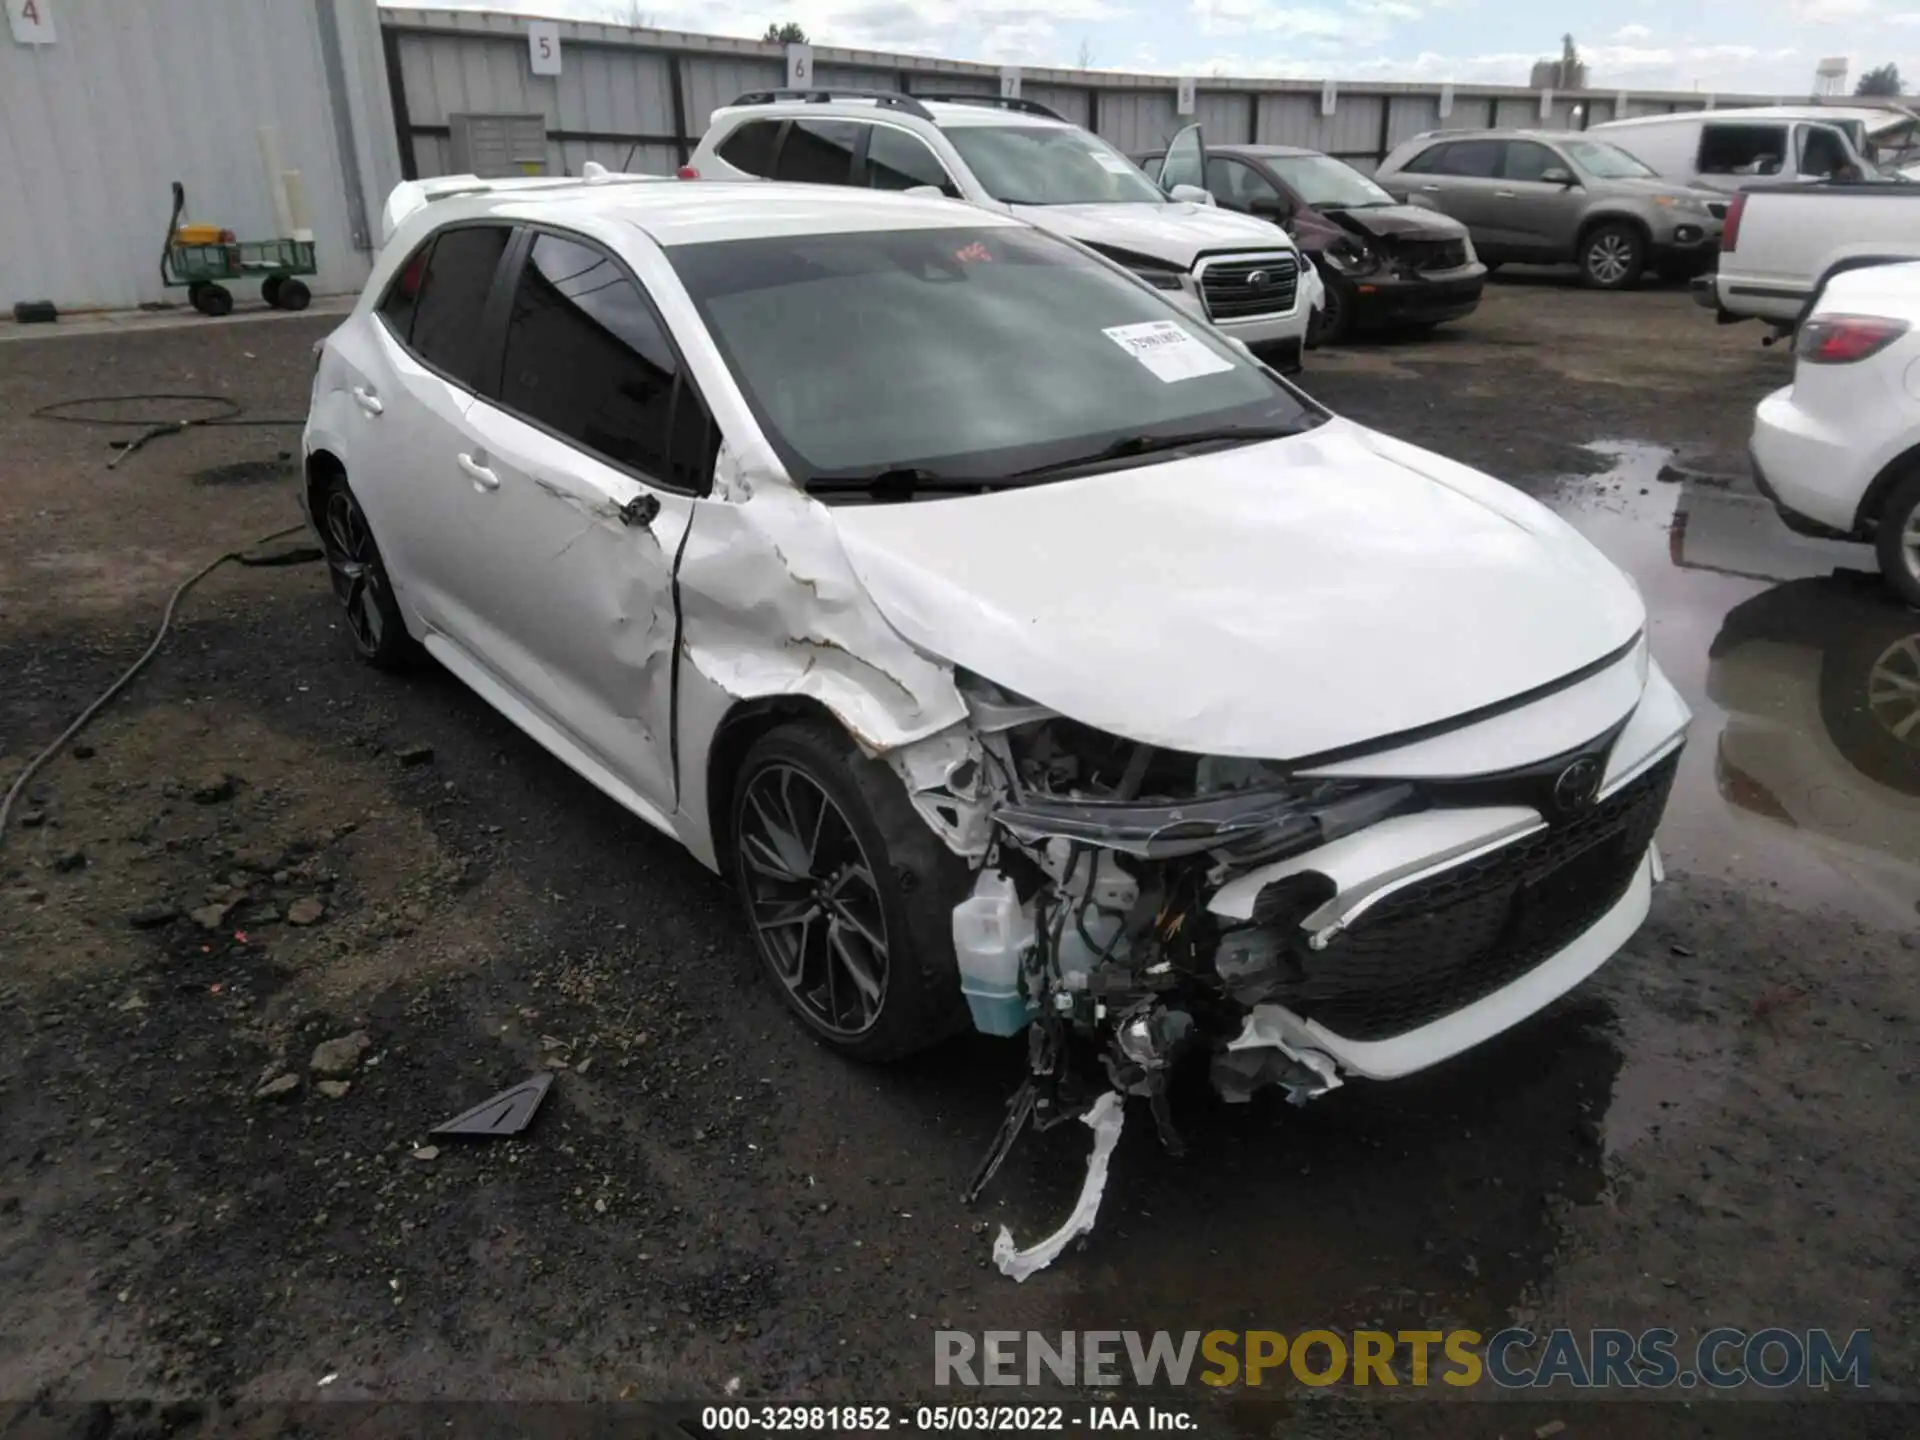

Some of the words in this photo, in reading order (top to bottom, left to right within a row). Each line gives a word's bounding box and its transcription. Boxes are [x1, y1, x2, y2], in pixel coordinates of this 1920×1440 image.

[22, 0, 40, 26] 4
[538, 36, 552, 60] 5
[794, 57, 805, 78] 6
[1006, 77, 1015, 96] 7
